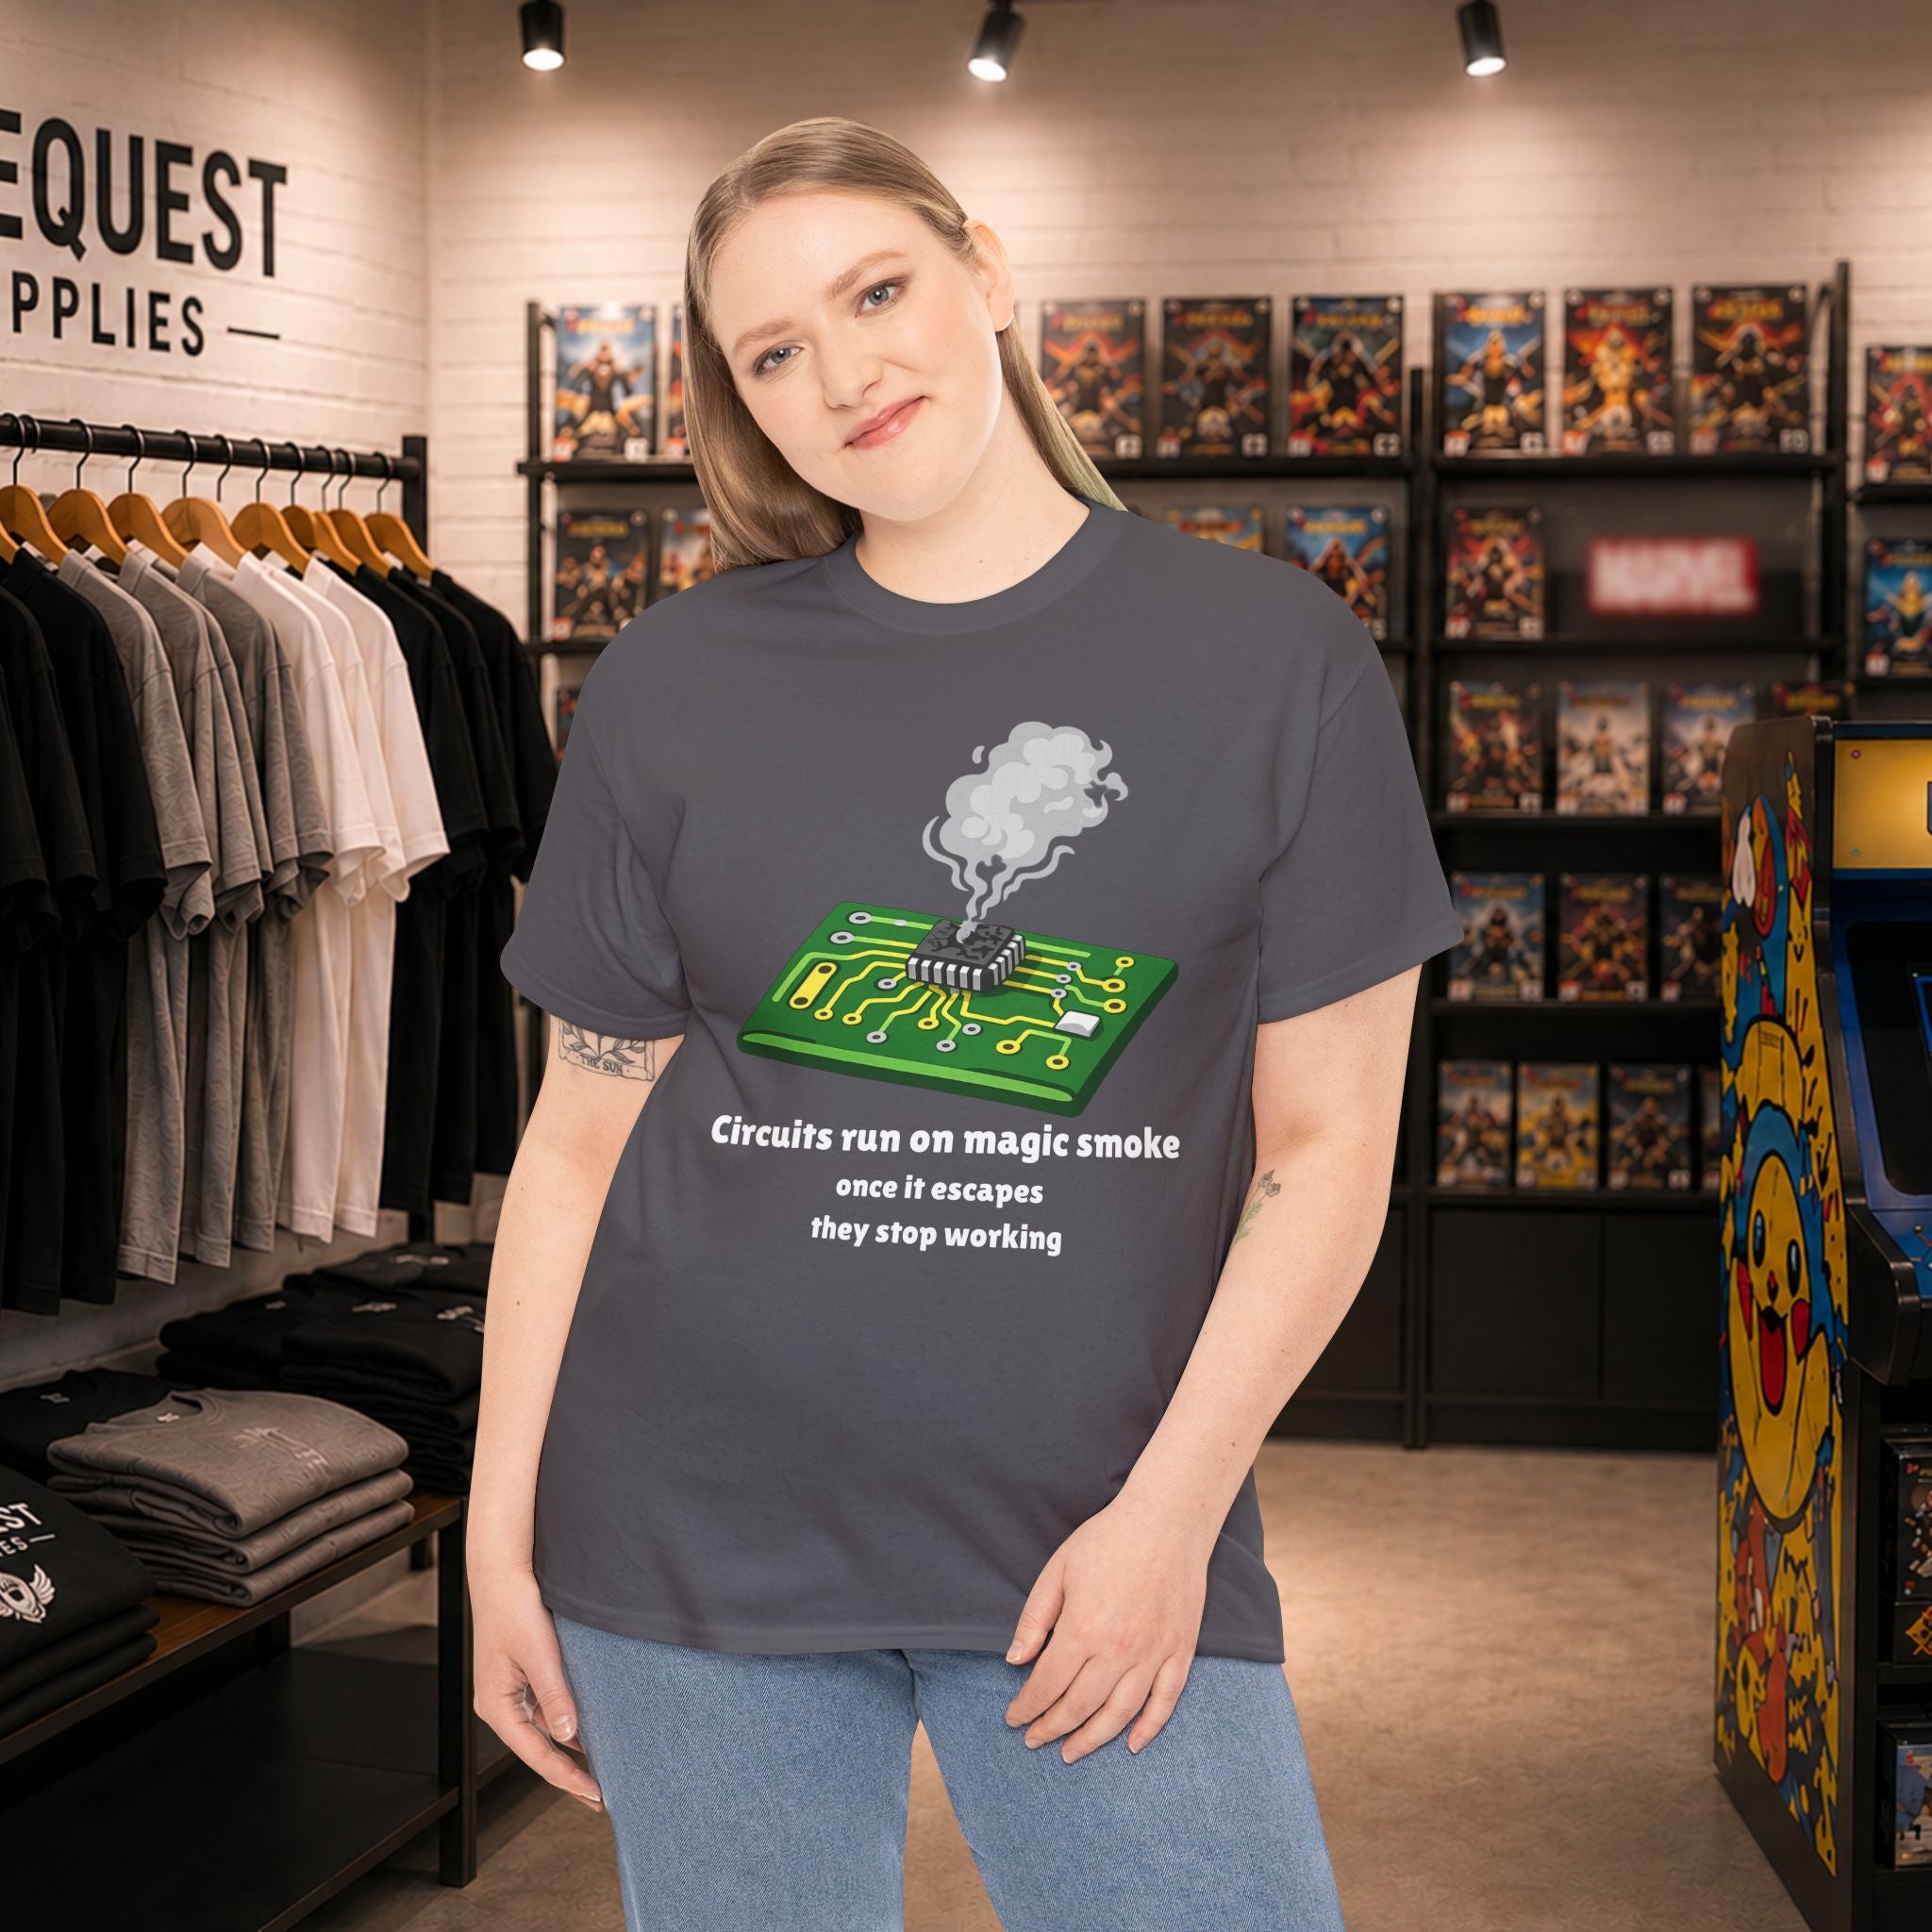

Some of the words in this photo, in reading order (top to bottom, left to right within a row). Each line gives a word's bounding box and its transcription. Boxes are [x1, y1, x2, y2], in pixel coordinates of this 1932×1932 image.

[12, 271, 205, 357] PPLIES
[581, 1054, 601, 1069] THE
[603, 1059, 624, 1074] SUN
[711, 1115, 834, 1150] Circuits
[841, 1128, 901, 1152] run
[909, 1129, 955, 1153] on
[963, 1124, 1070, 1163] magic
[1075, 1125, 1180, 1158] smoke
[835, 1176, 898, 1198] once
[904, 1174, 926, 1199] it
[930, 1181, 1043, 1208] escapes
[810, 1214, 871, 1247] they
[874, 1221, 938, 1252] stop
[943, 1223, 1062, 1257] working
